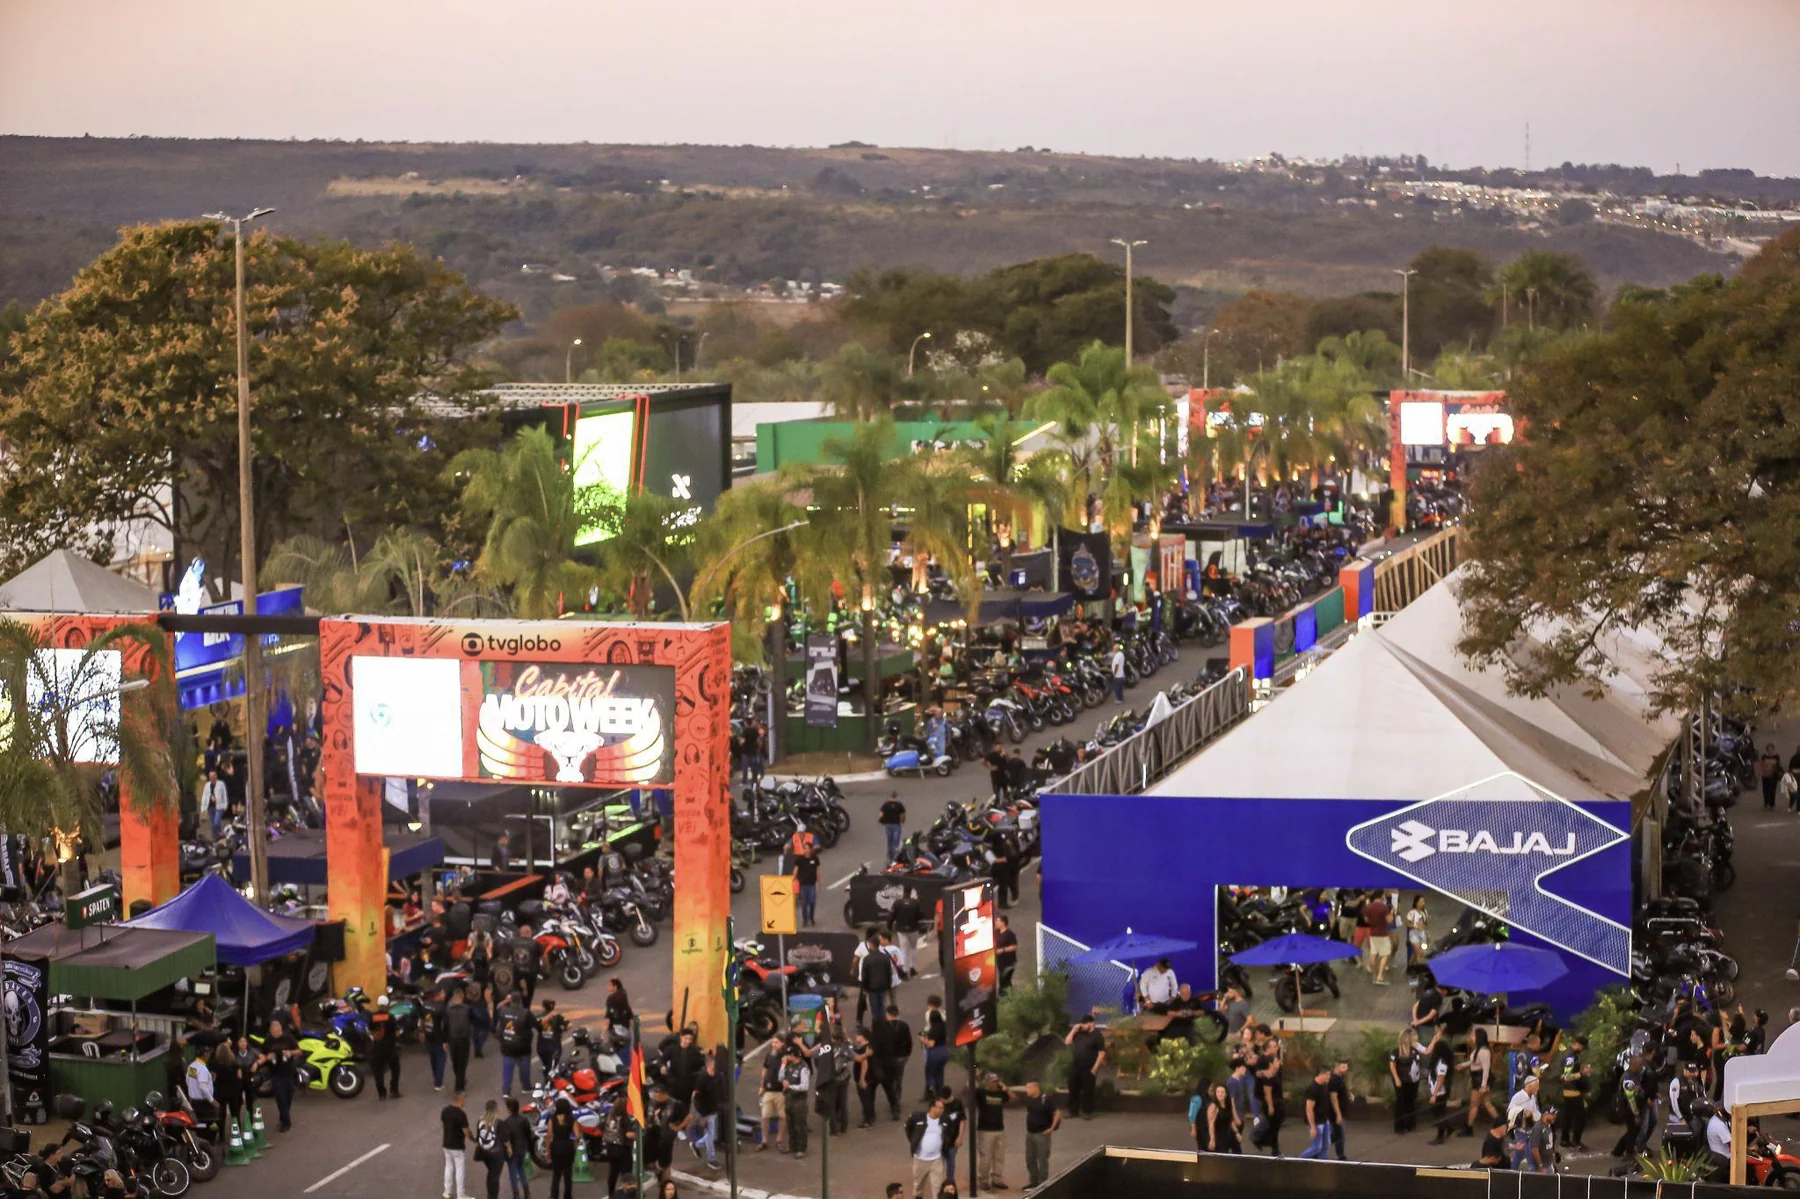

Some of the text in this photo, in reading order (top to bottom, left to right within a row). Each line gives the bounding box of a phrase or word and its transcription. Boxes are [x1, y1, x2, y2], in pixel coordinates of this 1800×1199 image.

[488, 634, 562, 656] tvglobo
[514, 664, 622, 700] Capital
[1439, 829, 1576, 856] BAJAJ
[88, 896, 111, 918] SPATEN
